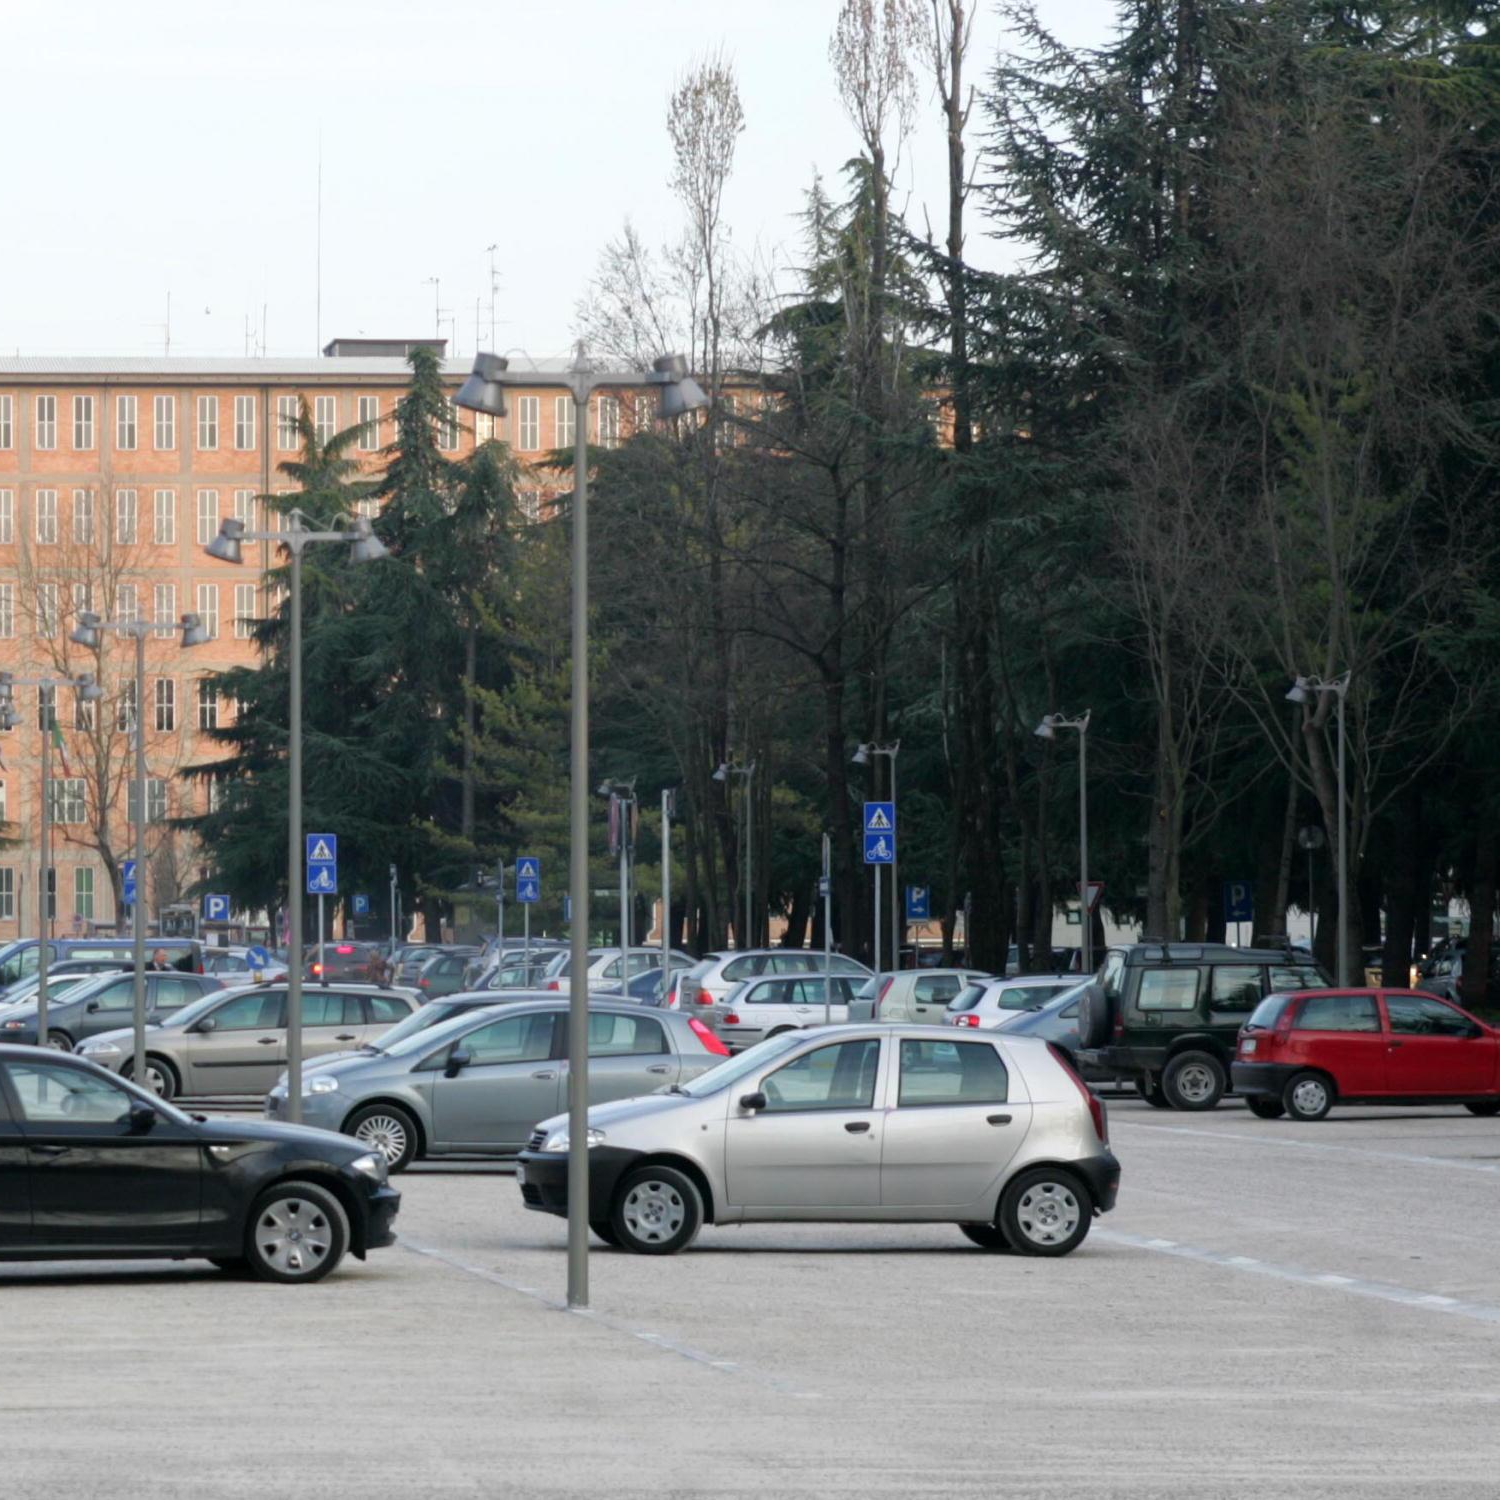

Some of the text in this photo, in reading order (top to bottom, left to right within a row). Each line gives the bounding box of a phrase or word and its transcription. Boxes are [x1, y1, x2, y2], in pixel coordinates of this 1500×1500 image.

[912, 887, 925, 903] P
[1231, 885, 1245, 906] P
[210, 898, 224, 918] P
[356, 898, 365, 912] P
